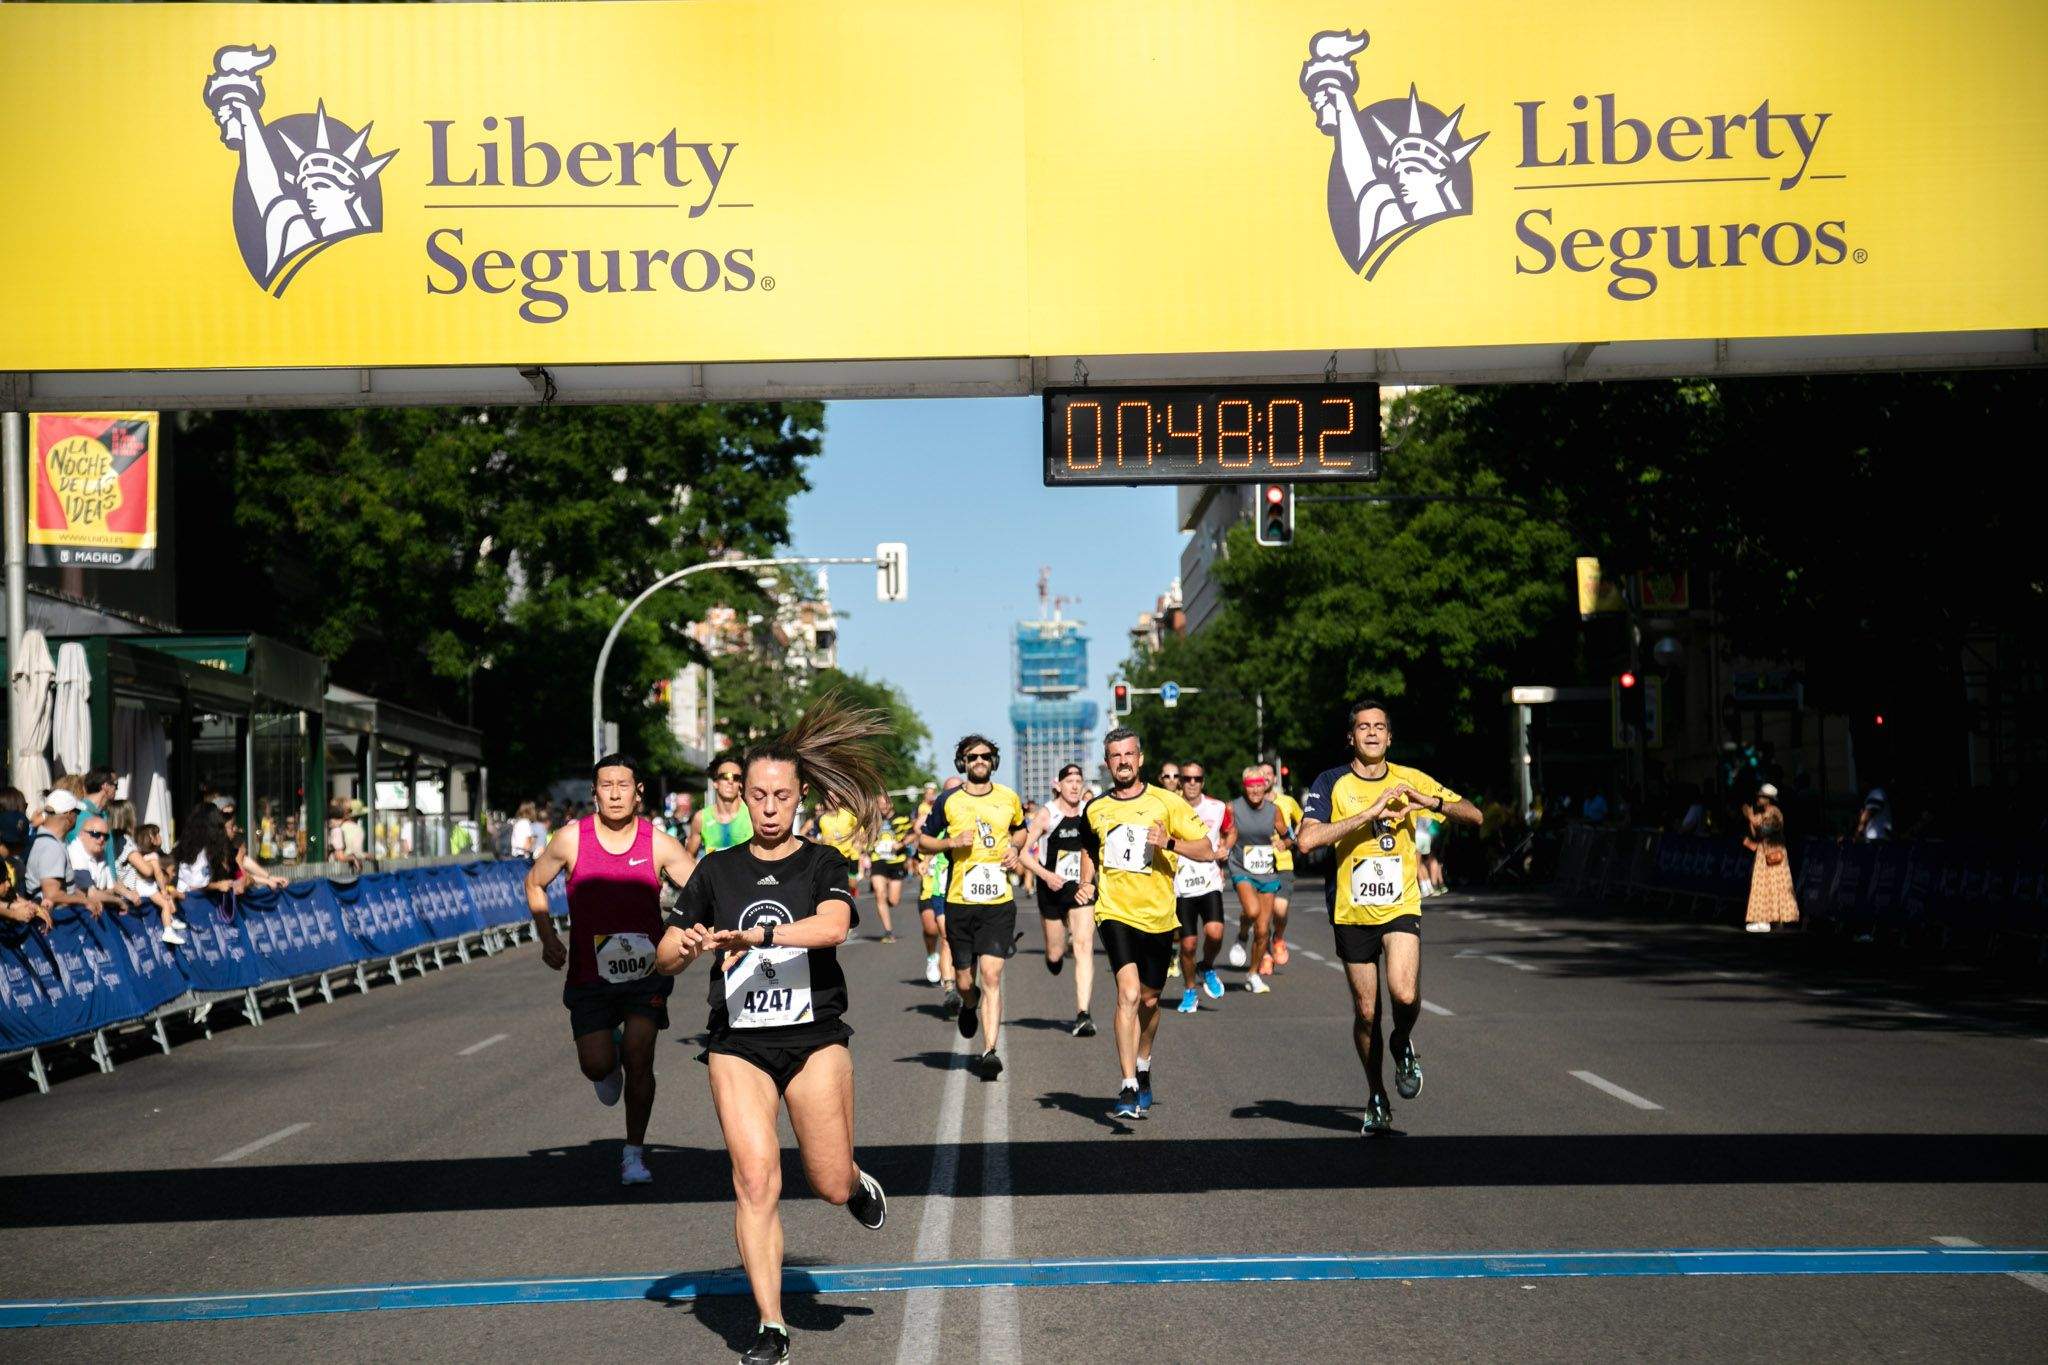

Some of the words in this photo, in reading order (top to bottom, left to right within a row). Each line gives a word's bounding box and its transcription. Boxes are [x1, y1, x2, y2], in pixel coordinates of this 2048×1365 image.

[1514, 93, 1833, 190] Liberty
[423, 116, 739, 218] Liberty
[68, 440, 87, 454] LA
[50, 448, 109, 476] NOCHE
[60, 477, 78, 492] DE
[83, 477, 115, 496] LAS
[66, 494, 116, 524] IDEAS
[75, 551, 123, 564] MADRID
[1383, 838, 1394, 849] 13
[1123, 848, 1131, 861] 4
[971, 883, 998, 896] 3683
[1360, 882, 1394, 897] 2964
[608, 956, 646, 975] 3004
[743, 988, 793, 1013] 4247
